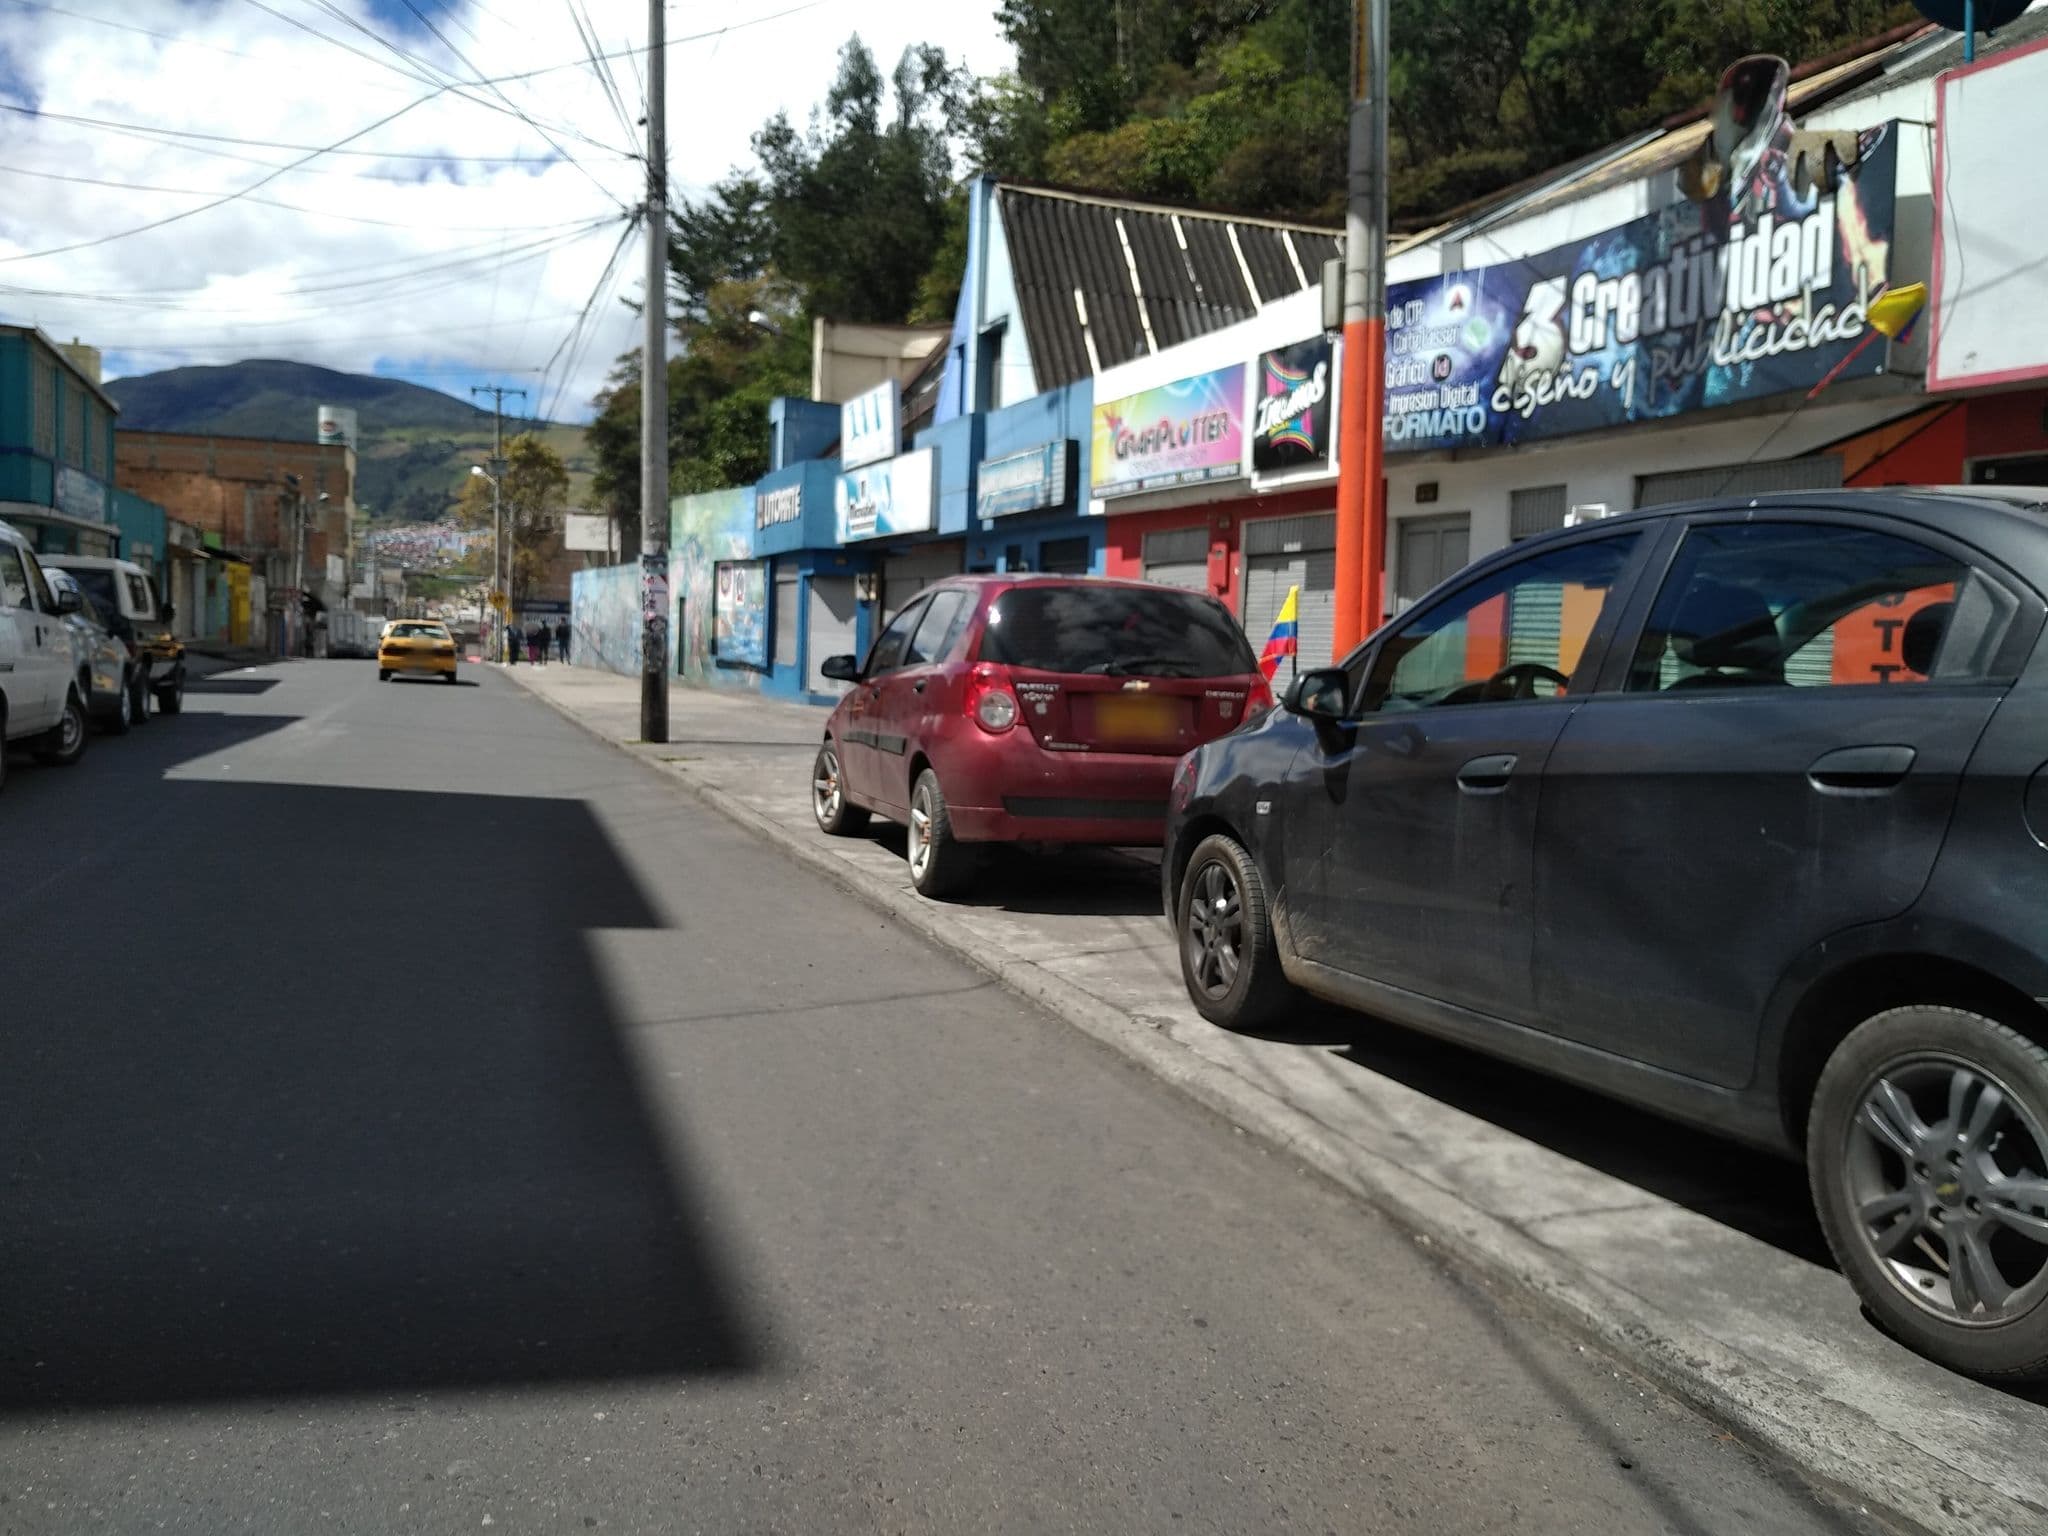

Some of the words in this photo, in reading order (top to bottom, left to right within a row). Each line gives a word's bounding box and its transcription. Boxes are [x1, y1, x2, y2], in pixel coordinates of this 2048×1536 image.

[1569, 198, 1835, 354] Creatividad
[1611, 355, 1636, 409] y
[1650, 263, 1869, 404] publicidad
[1382, 406, 1487, 440] FORMATO
[1440, 381, 1480, 411] Digital
